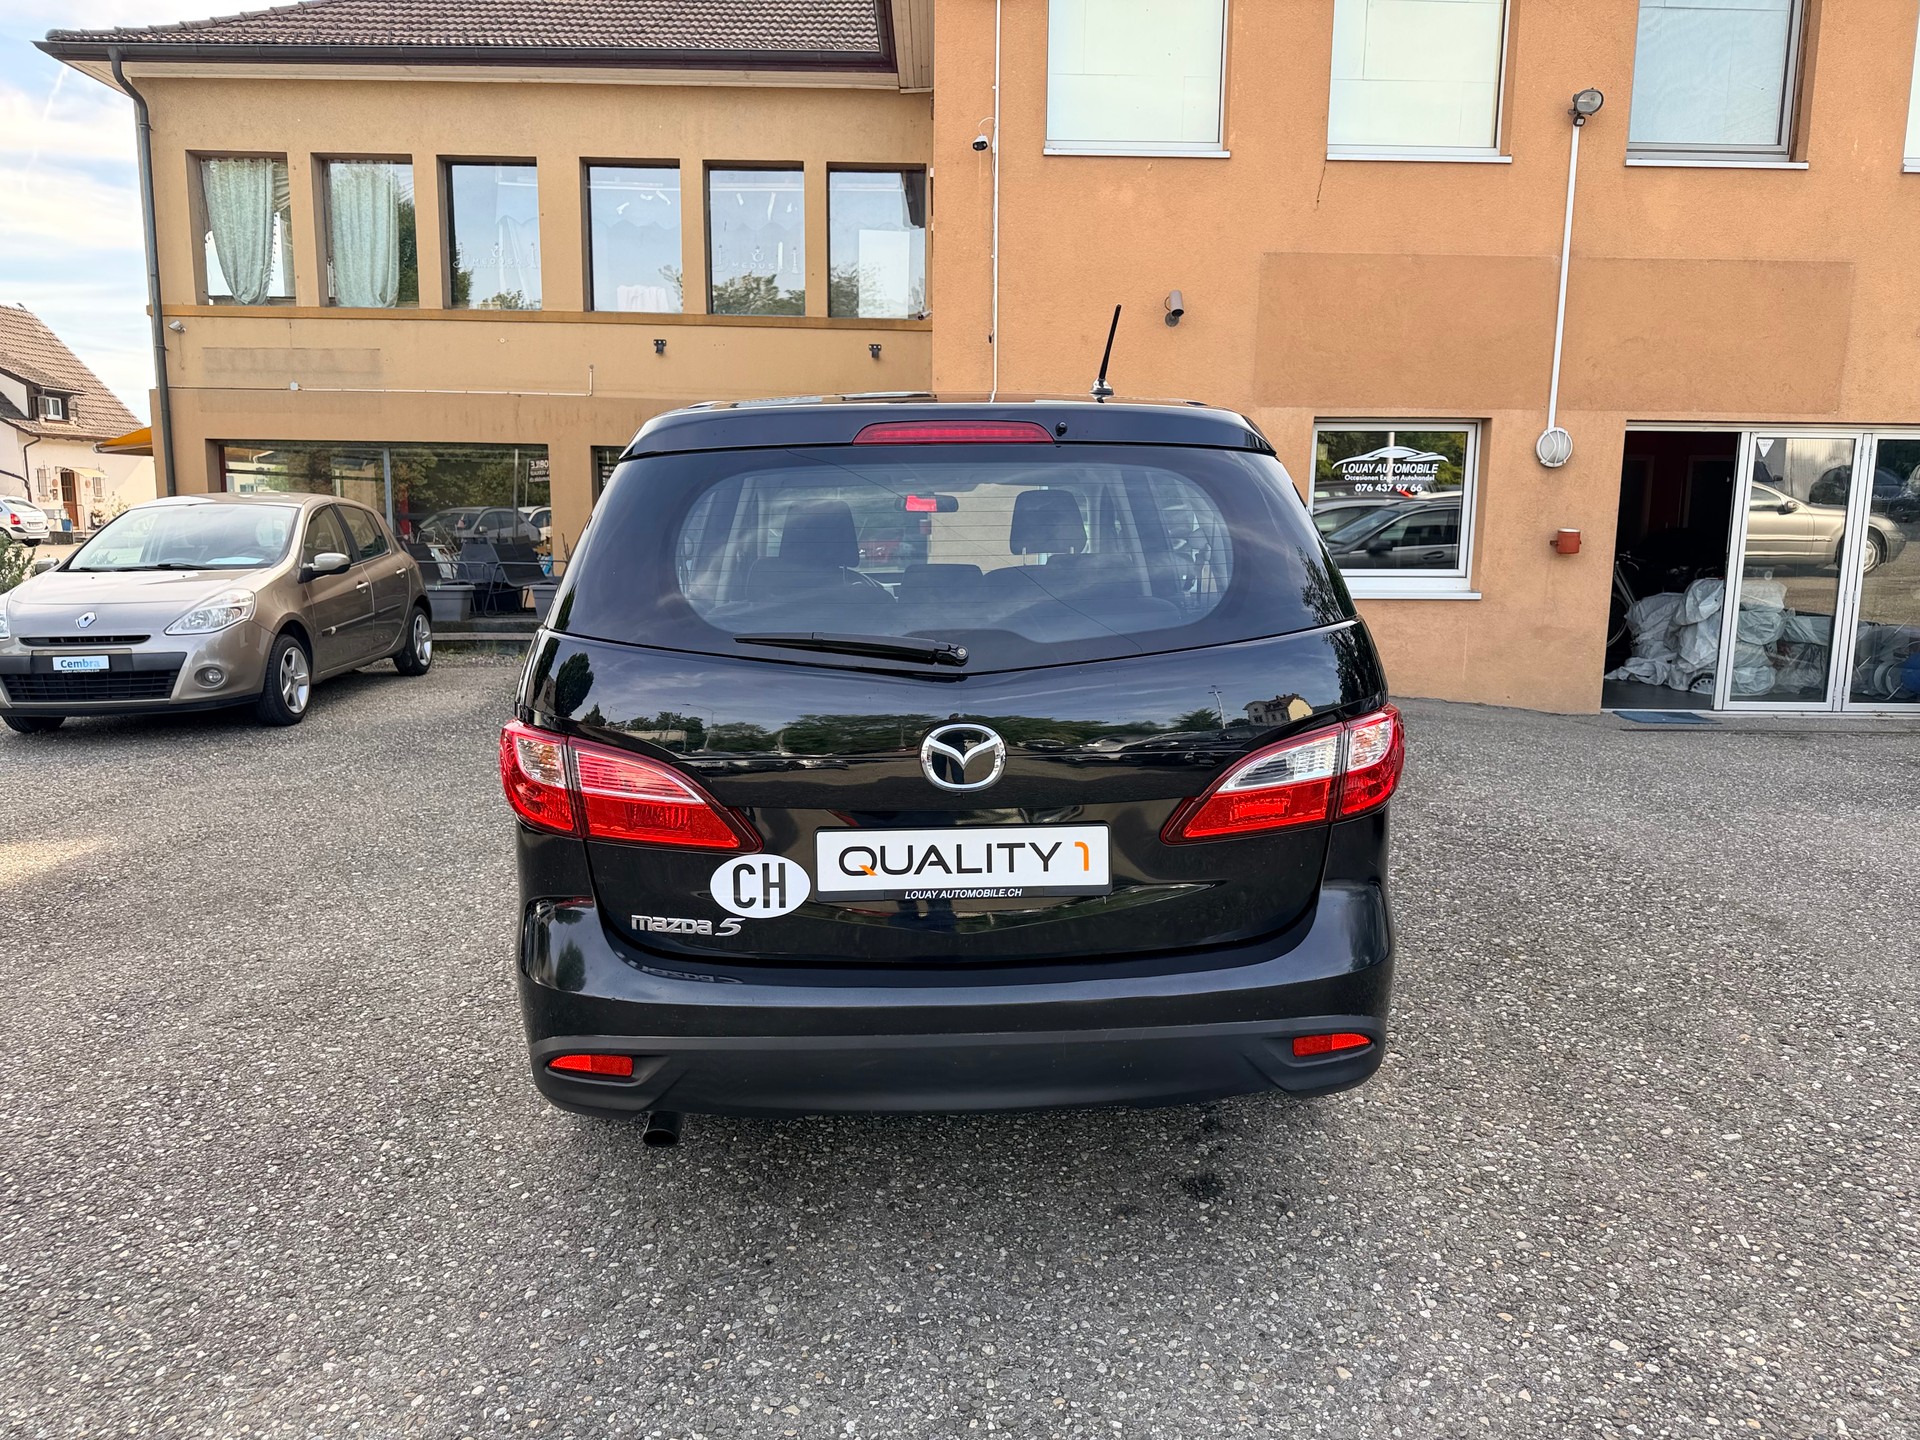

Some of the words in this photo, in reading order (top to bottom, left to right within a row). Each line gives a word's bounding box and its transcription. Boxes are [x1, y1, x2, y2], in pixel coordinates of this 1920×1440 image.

[1342, 463, 1376, 474] LOUAY
[1375, 463, 1439, 474] AUTOMOBILE
[1355, 483, 1373, 492] 076
[1375, 483, 1393, 492] 437
[1396, 483, 1408, 492] 97
[1410, 483, 1423, 492] 66
[60, 659, 100, 668] Cembra
[838, 841, 1063, 877] QUALITY
[1074, 841, 1090, 871] 1
[732, 862, 787, 909] CH
[904, 890, 939, 900] LOUAY
[938, 888, 1023, 899] AUTOMOBILE.CH
[714, 917, 746, 937] 5
